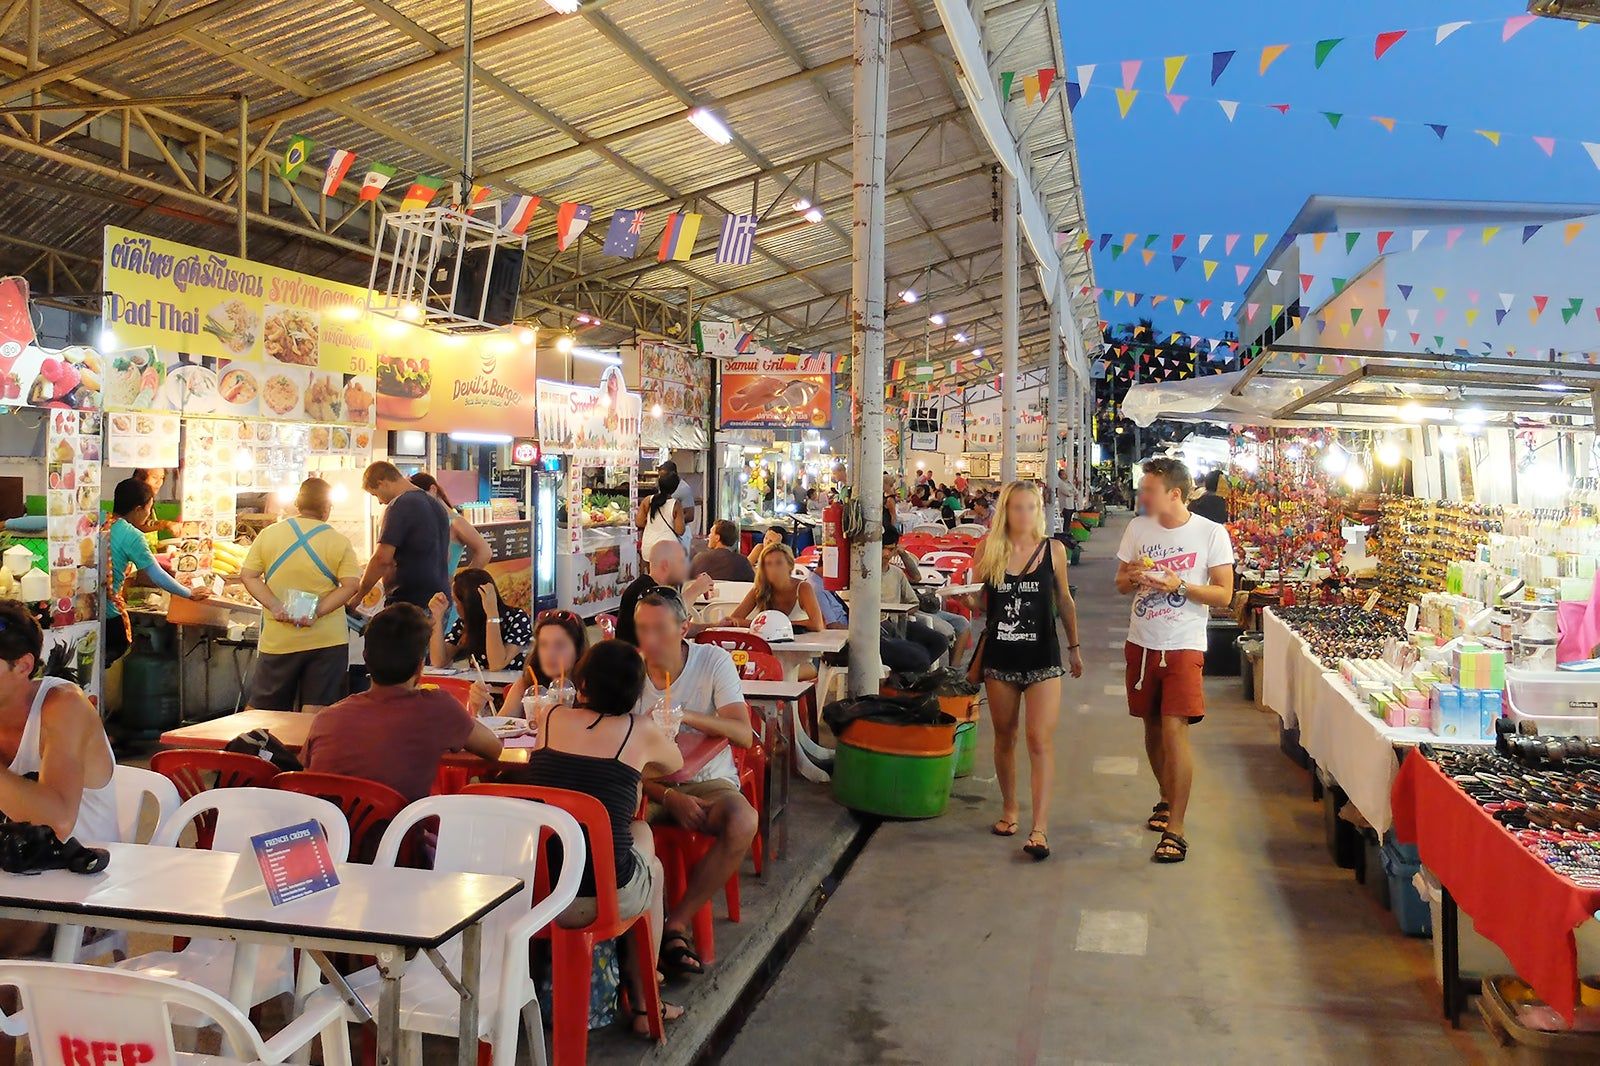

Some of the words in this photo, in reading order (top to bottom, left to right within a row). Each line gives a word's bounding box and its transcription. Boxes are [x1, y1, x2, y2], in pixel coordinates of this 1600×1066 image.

[111, 293, 200, 335] Pad-Thai
[725, 358, 758, 371] Samui
[453, 376, 489, 401] Devil's
[490, 378, 521, 407] Burger
[732, 653, 745, 662] CP
[265, 835, 289, 847] FRENCH
